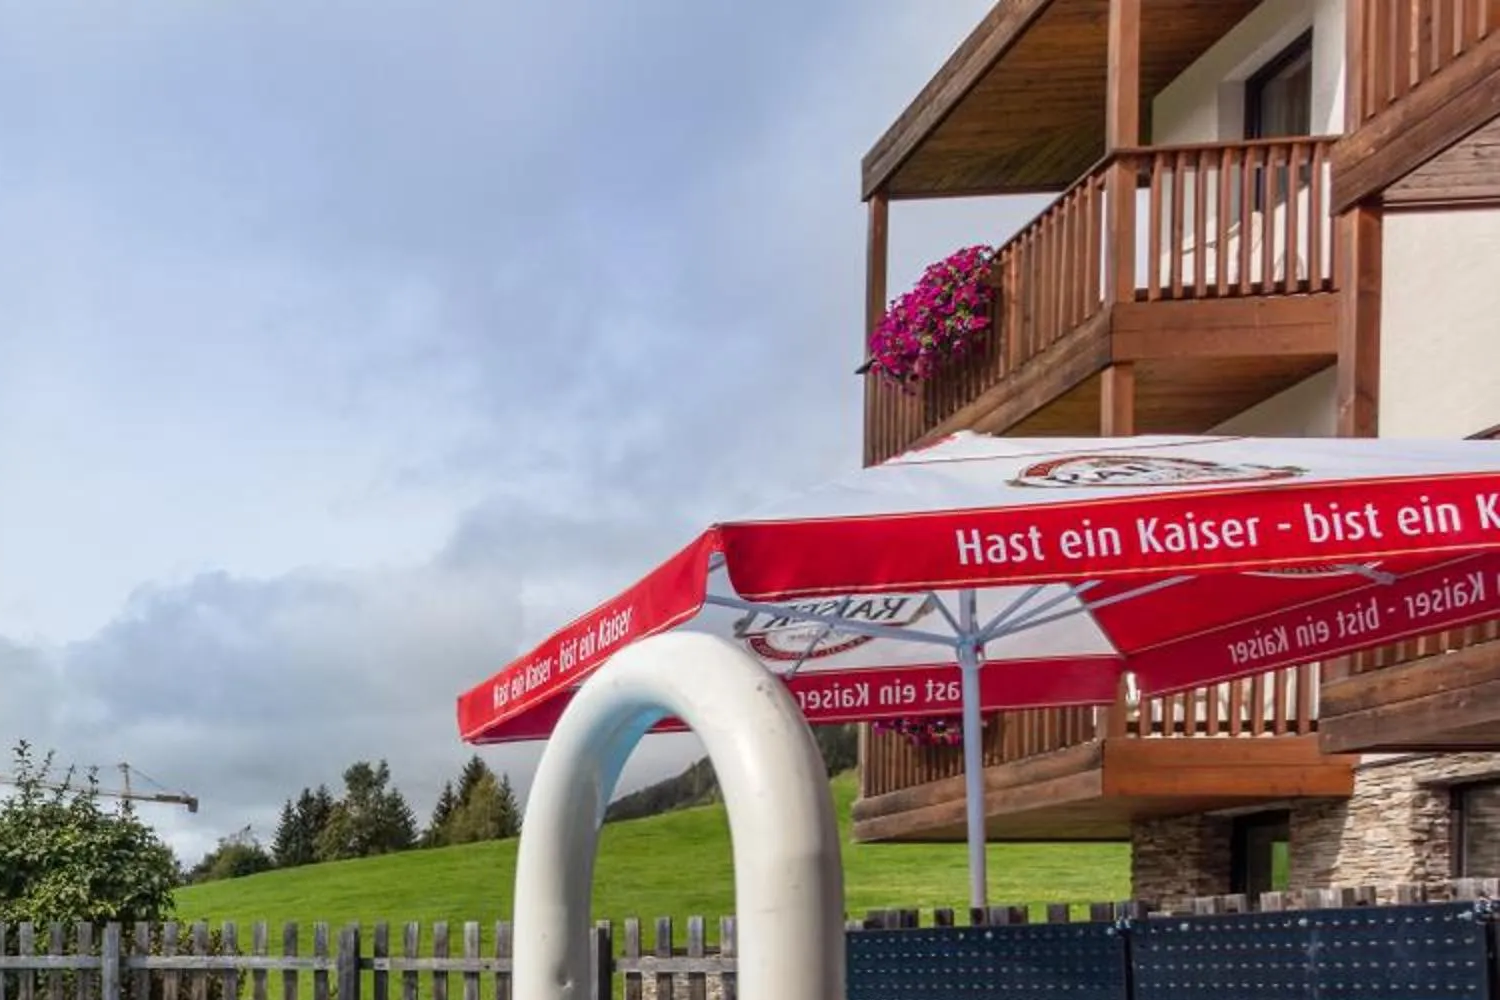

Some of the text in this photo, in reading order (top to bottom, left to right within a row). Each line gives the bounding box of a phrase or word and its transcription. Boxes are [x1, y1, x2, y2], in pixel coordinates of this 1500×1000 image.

[956, 525, 1046, 565] Hast
[1060, 519, 1122, 559] ein
[1136, 512, 1259, 554] Kaiser
[1303, 501, 1384, 544] bist
[1397, 495, 1462, 536] ein
[511, 669, 525, 700] ein
[526, 656, 552, 692] Kaiser
[559, 638, 577, 672] bist
[579, 626, 596, 660] ein
[598, 605, 633, 651] Kaiser
